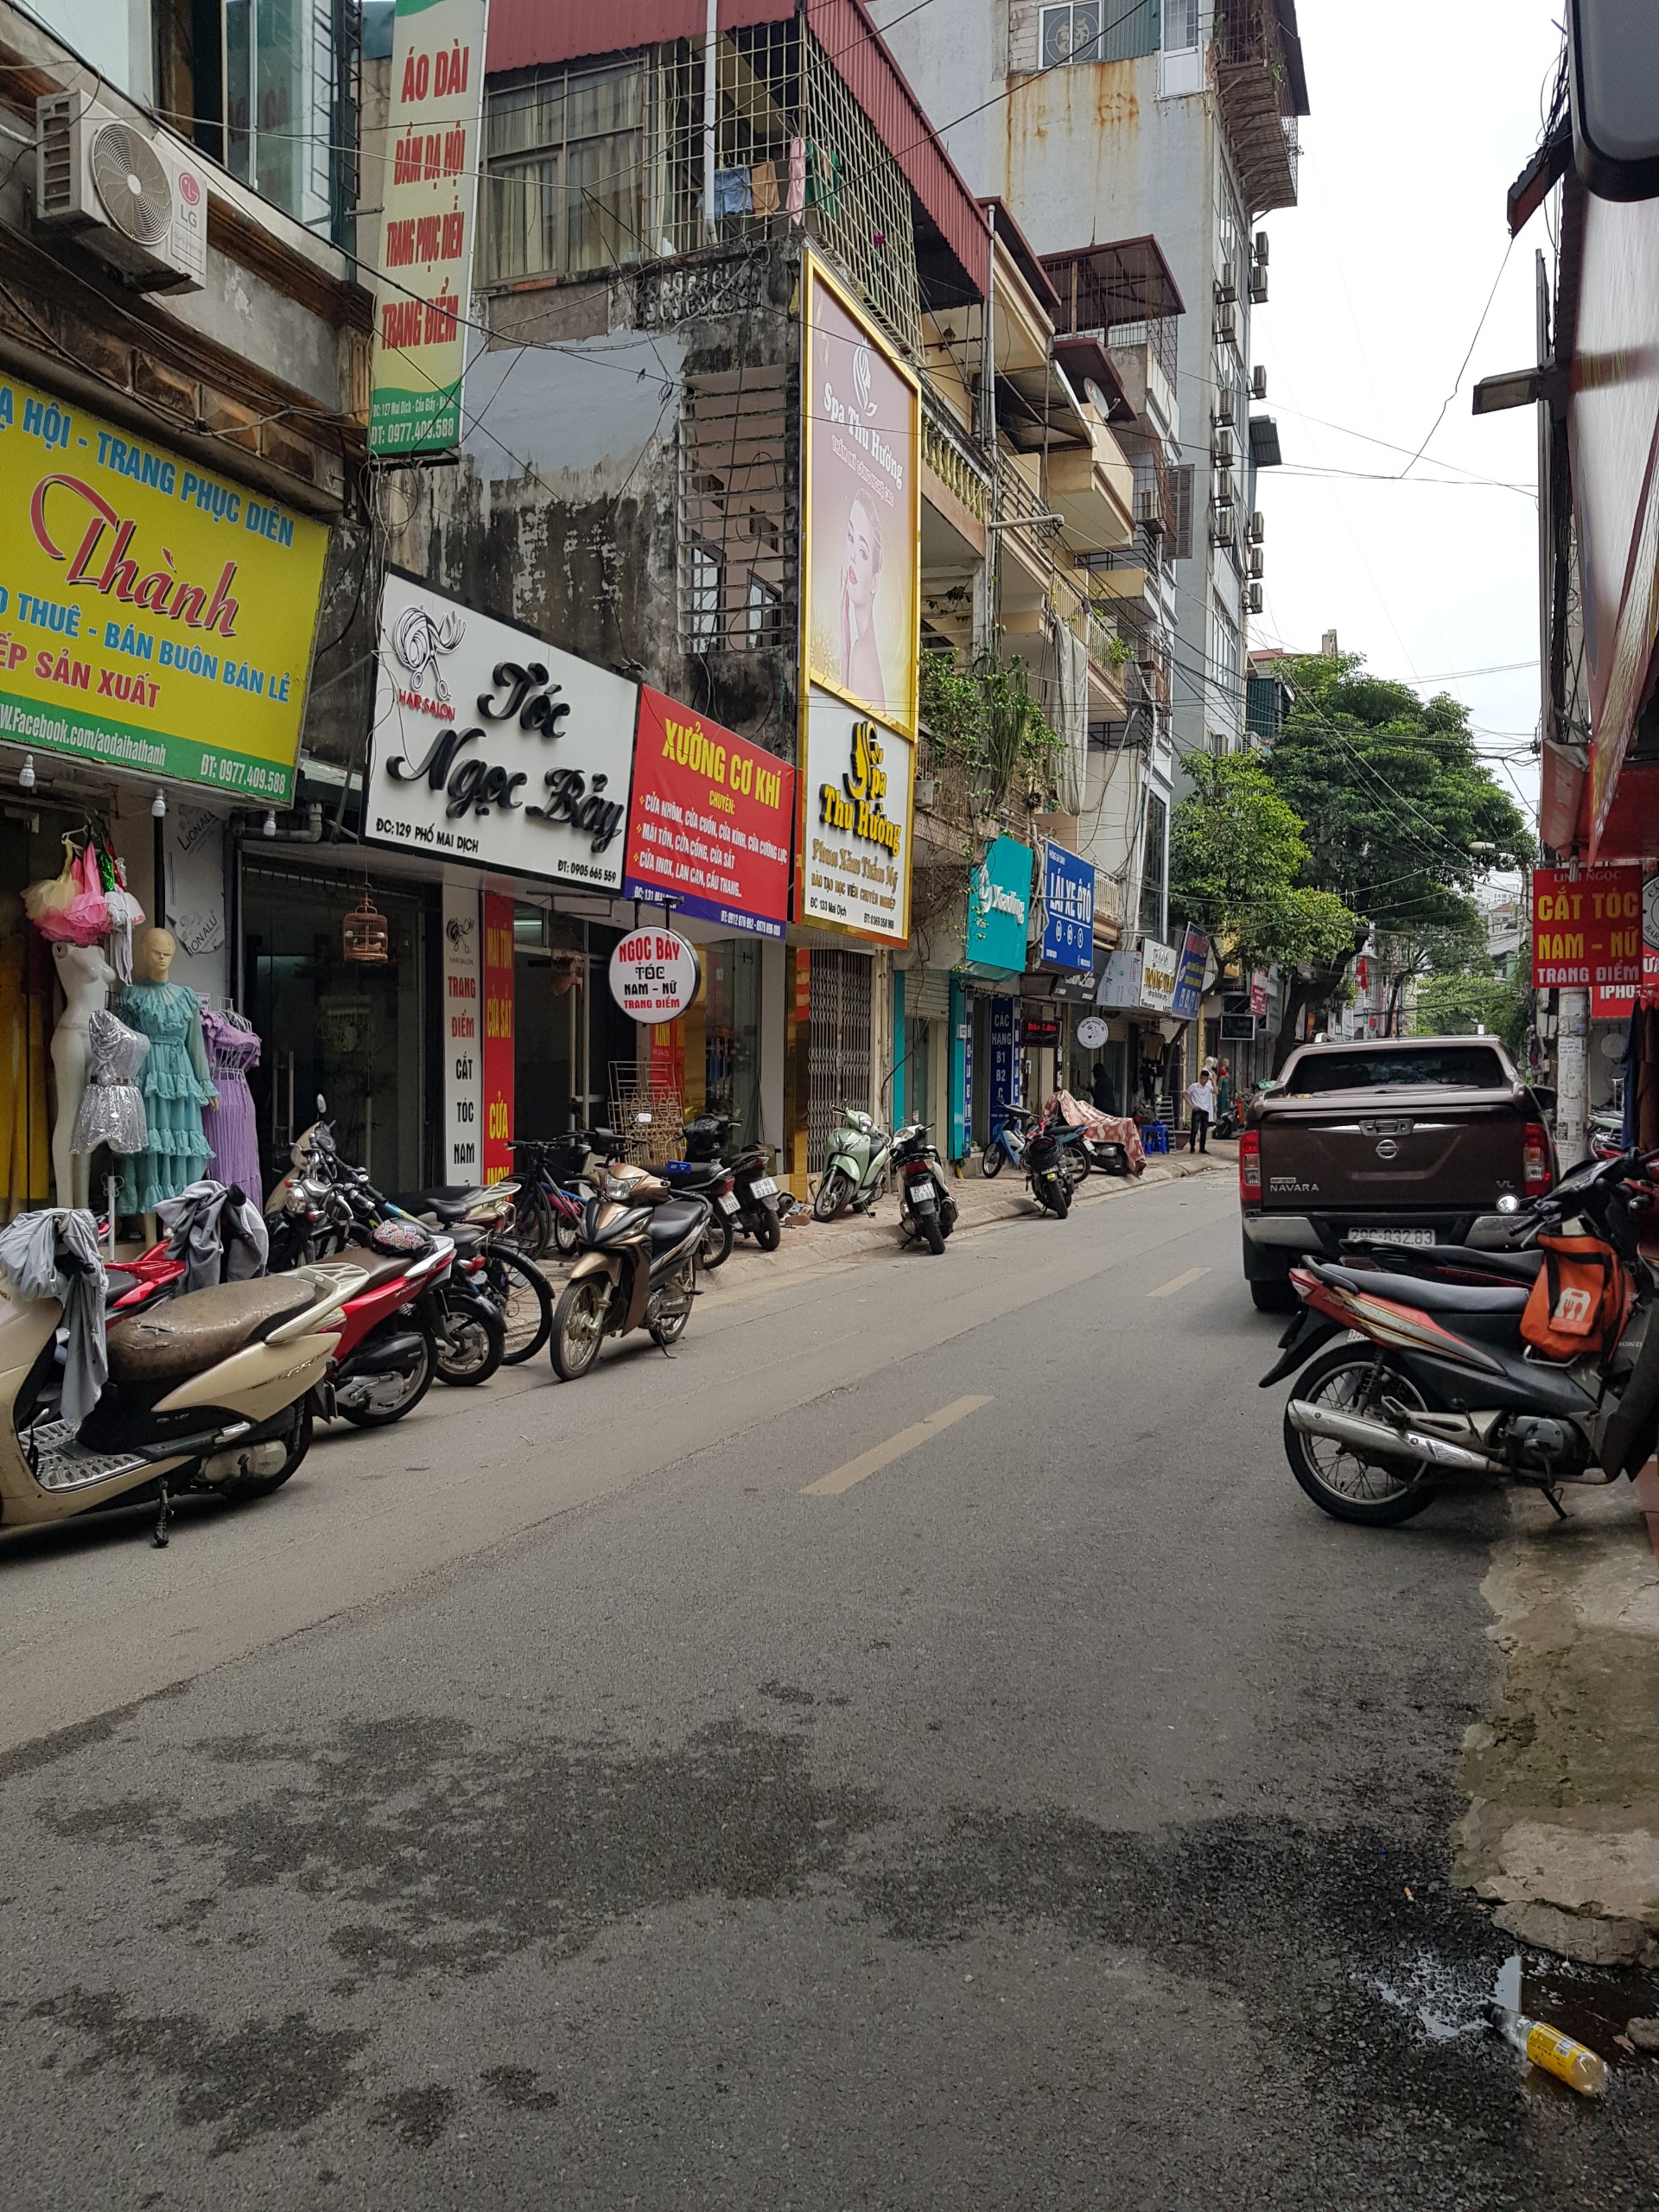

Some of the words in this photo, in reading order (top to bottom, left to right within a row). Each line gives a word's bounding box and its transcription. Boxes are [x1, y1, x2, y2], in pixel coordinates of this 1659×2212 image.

[401, 47, 429, 103] ÁO
[434, 38, 469, 98] DÀI
[443, 120, 466, 187] HỘI
[181, 204, 197, 228] LG
[386, 219, 415, 268] TRANG
[416, 213, 442, 273] PHỤC
[382, 299, 422, 350] TRANG
[424, 276, 459, 346] ĐIỂM
[824, 382, 844, 426] Spa
[849, 405, 868, 451] Thu
[871, 430, 903, 490] Hường
[22, 397, 72, 451] HỘI
[97, 430, 176, 495] TRANG
[181, 470, 241, 524] PHỤC
[30, 474, 238, 638] Thành
[17, 591, 81, 639] THUÊ
[104, 620, 153, 659] BÁN
[159, 639, 219, 680] BUÔN
[223, 655, 264, 696] BÁN
[268, 671, 291, 703] LẺ
[35, 648, 92, 691] SẢN
[96, 668, 162, 709] XUẤT
[422, 698, 456, 721] SALON
[477, 661, 571, 739] Tóc
[219, 759, 286, 794] 0977.409.588
[386, 727, 527, 819] Ngọc
[661, 718, 726, 784] XƯỞNG
[729, 753, 753, 796] CƠ
[755, 766, 782, 810] KHÍ
[645, 791, 659, 814] CỬA
[685, 807, 698, 830] CỬA
[820, 784, 853, 830] Thu
[415, 823, 435, 842] PHỐ
[436, 831, 454, 848] MAI
[457, 836, 480, 853] DỊCH
[642, 823, 657, 842] MÁI
[675, 831, 689, 855] CỬA
[570, 861, 588, 879] 0905
[589, 865, 603, 880] 665
[603, 868, 617, 884] 559
[639, 848, 654, 870] CỬA
[676, 862, 689, 881] LAN
[1050, 868, 1064, 912] LÁI
[1065, 879, 1076, 917] XE
[1538, 885, 1584, 922] CẮT
[1592, 887, 1640, 919] TÓC
[619, 936, 652, 965] NGỌC
[656, 933, 680, 961] BẢY
[1538, 933, 1585, 960] NAM
[1611, 925, 1638, 958] NỮ
[448, 976, 475, 998] TRANG
[624, 983, 649, 995] NAM
[662, 980, 677, 995] NỮ
[635, 963, 665, 980] TÓC
[1537, 967, 1590, 983] TRANG
[1595, 959, 1639, 982] ĐIỂM
[623, 999, 652, 1009] TRANG
[656, 995, 680, 1008] ĐIỂM
[994, 1012, 1010, 1027] CÁC
[452, 1008, 474, 1038] ĐIỂM
[456, 1051, 473, 1080] CẮT
[457, 1097, 474, 1122] TÓC
[489, 1090, 508, 1139] CỬA
[454, 1143, 474, 1164] NAM
[1270, 1184, 1319, 1192] NAVARA
